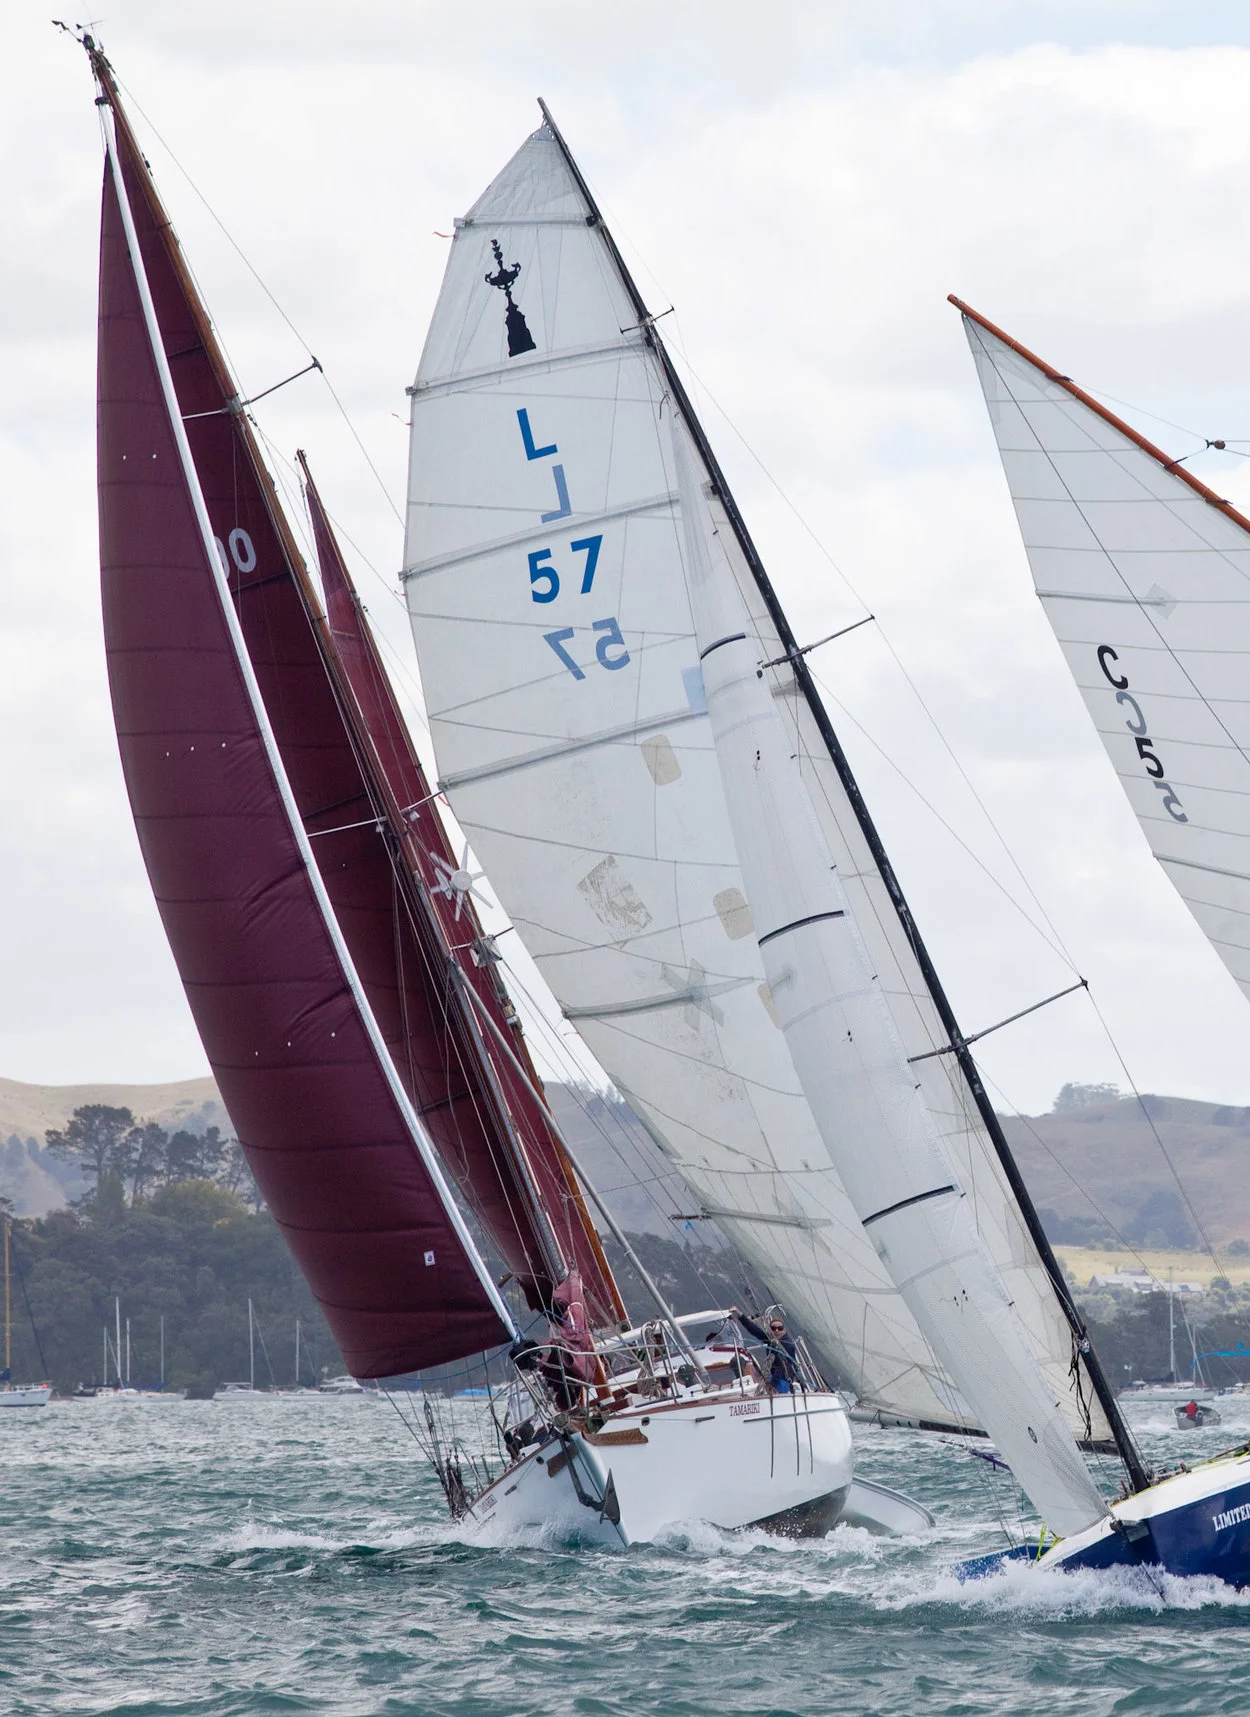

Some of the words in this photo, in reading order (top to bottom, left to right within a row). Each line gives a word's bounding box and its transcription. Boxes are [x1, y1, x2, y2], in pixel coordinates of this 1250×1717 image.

[516, 408, 558, 461] L
[527, 535, 603, 603] 57
[1097, 645, 1128, 690] C
[1134, 737, 1164, 778] 5
[729, 1402, 761, 1417] TAMARIKI
